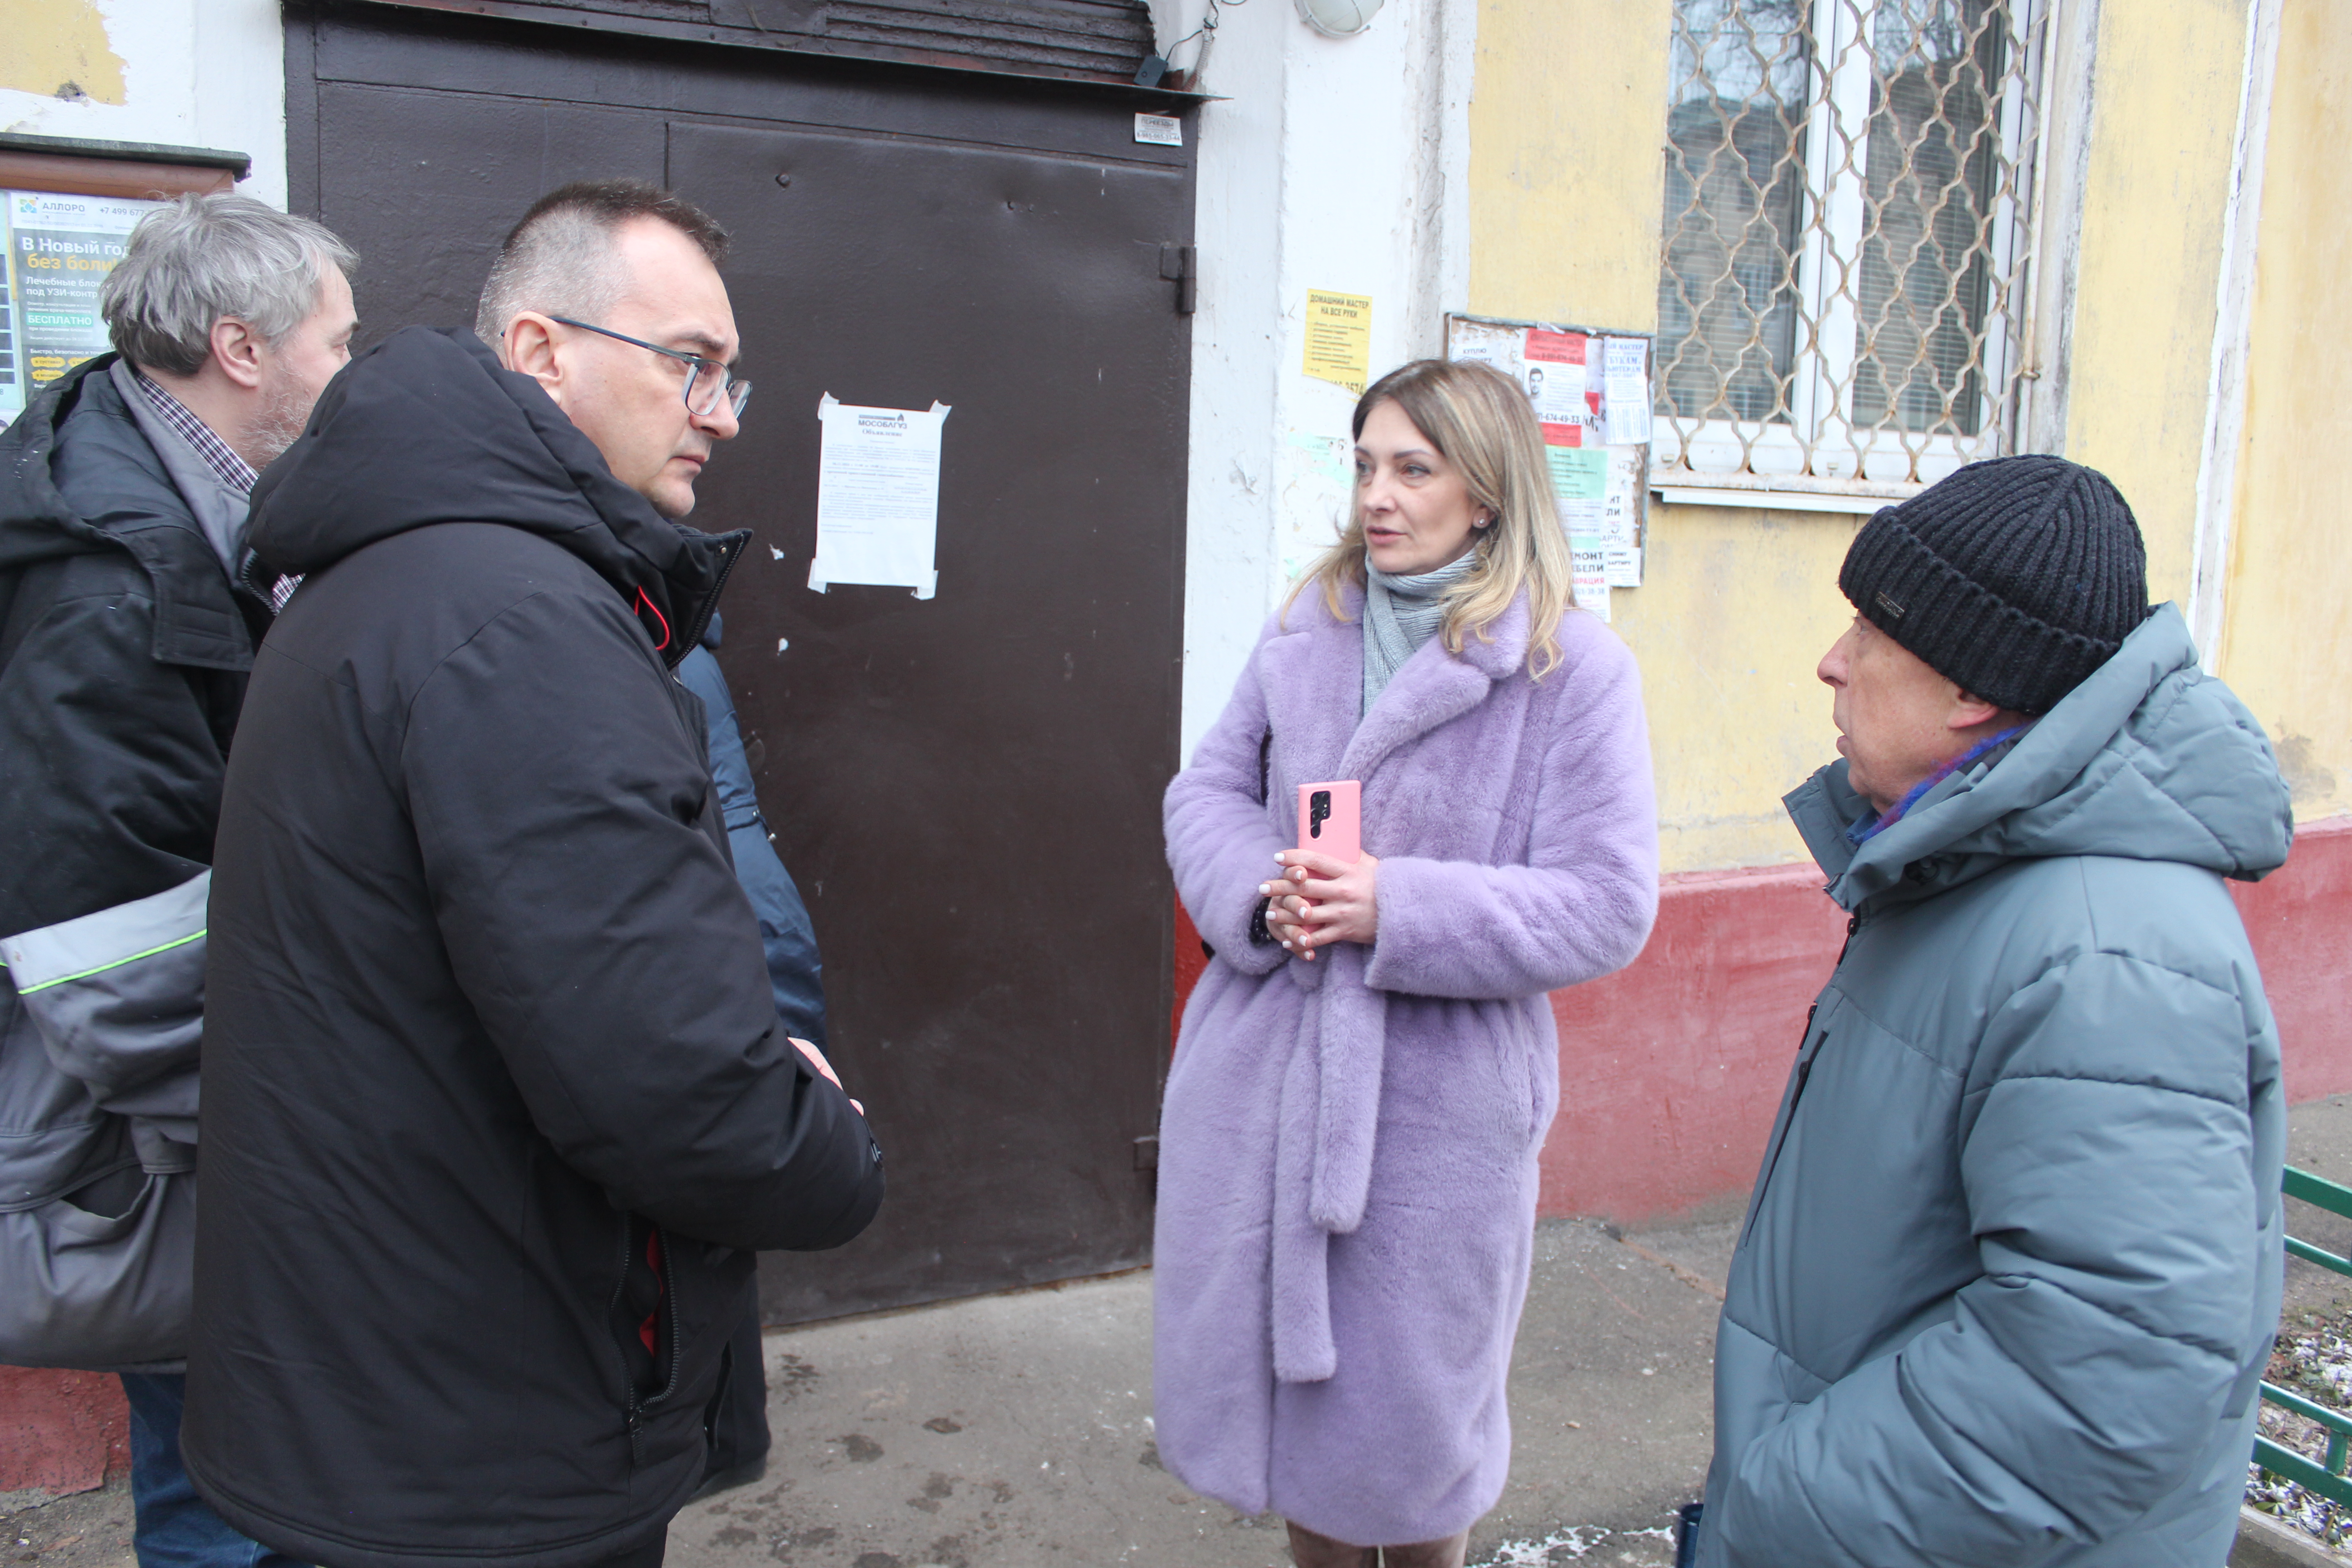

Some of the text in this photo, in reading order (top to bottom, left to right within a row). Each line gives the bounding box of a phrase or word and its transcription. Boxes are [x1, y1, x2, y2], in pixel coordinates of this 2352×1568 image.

[43, 202, 85, 212] АЛЛОРО
[22, 237, 34, 250] В
[39, 238, 99, 255] Новый
[27, 253, 61, 270] без
[26, 276, 76, 287] Лечебные
[26, 288, 98, 299] под УЗИ-контр
[1310, 294, 1369, 309] ДОМАШНИЙ МАСТЕР
[1321, 306, 1357, 318] НА ВСЕ РУКИ
[28, 315, 92, 325] БЕСПЛАТНО
